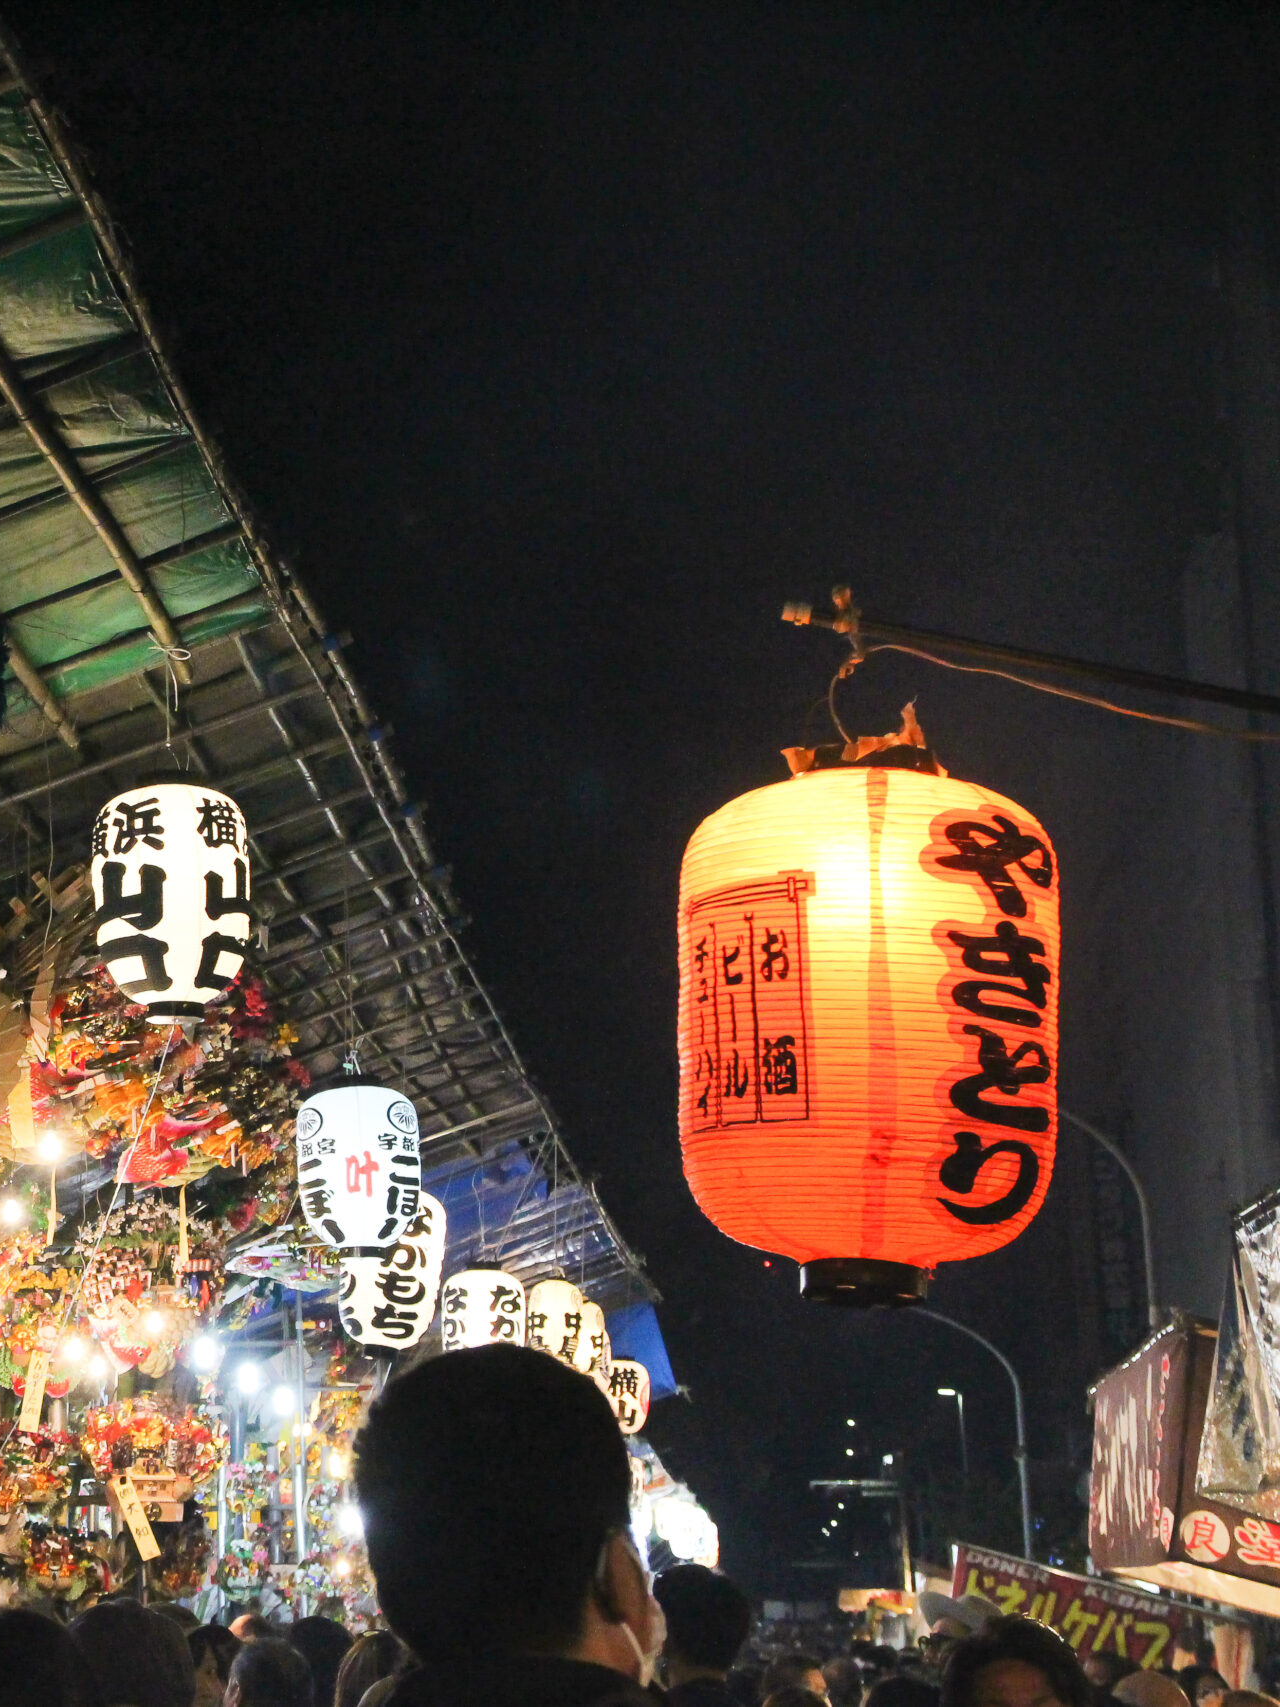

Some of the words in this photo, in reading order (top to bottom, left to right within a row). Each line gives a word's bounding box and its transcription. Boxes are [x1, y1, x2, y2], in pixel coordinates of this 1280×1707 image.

[196, 798, 248, 857] 横
[722, 935, 748, 1098] ビール
[935, 814, 1053, 1225] やきとり
[377, 1133, 420, 1152] 宇都
[345, 1150, 380, 1198] 叶
[966, 1551, 1051, 1584] DONER
